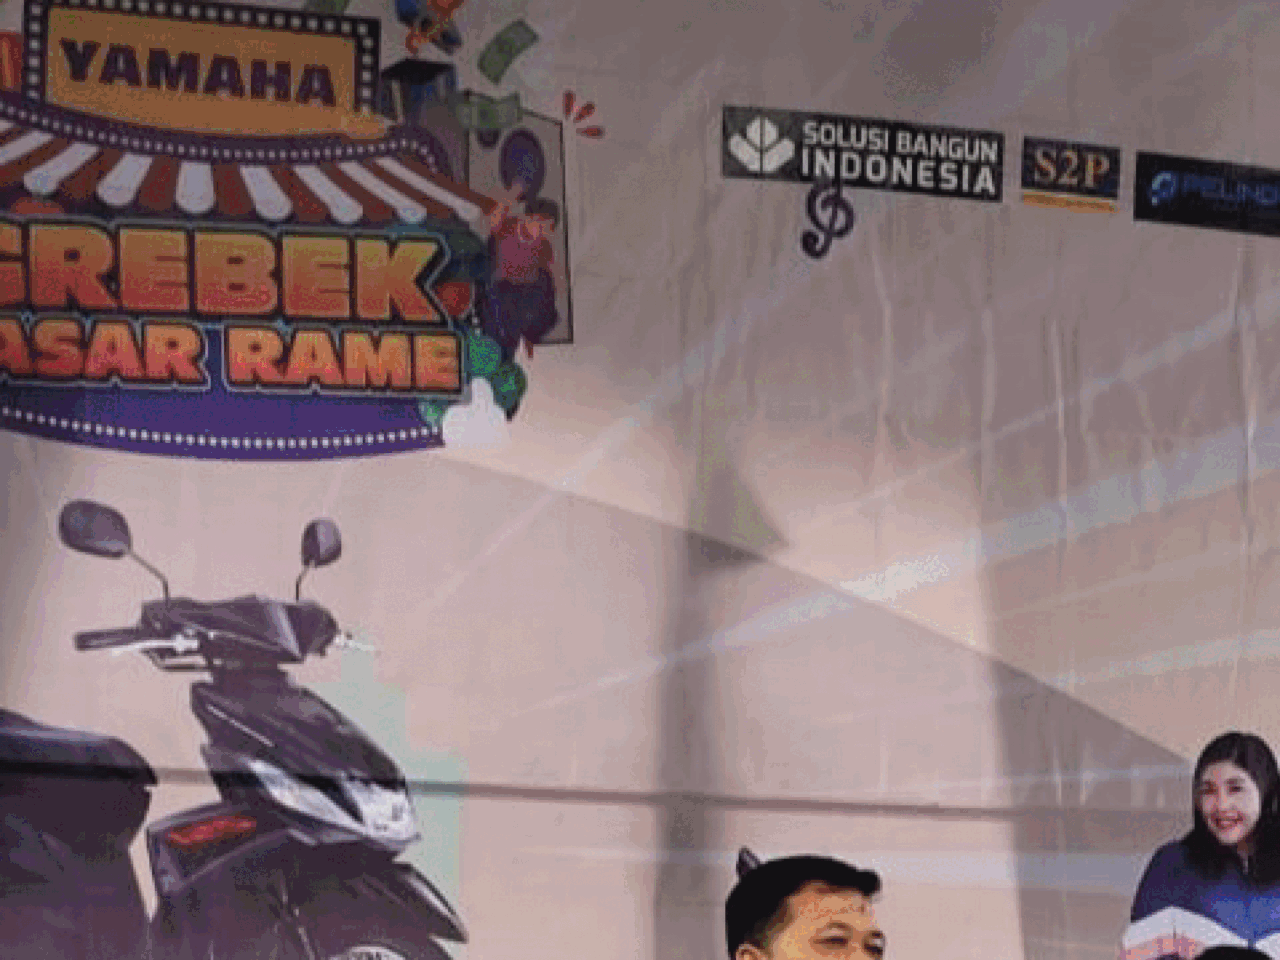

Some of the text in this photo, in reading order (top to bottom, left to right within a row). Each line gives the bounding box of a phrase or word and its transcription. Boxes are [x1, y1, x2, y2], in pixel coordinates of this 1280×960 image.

[59, 36, 337, 106] YAMAHA
[801, 120, 999, 163] SOLUSI BANGUN
[1033, 144, 1111, 190] S2P
[801, 147, 997, 195] INDONESIA
[0, 222, 447, 323] REBEK
[225, 324, 463, 389] RAME
